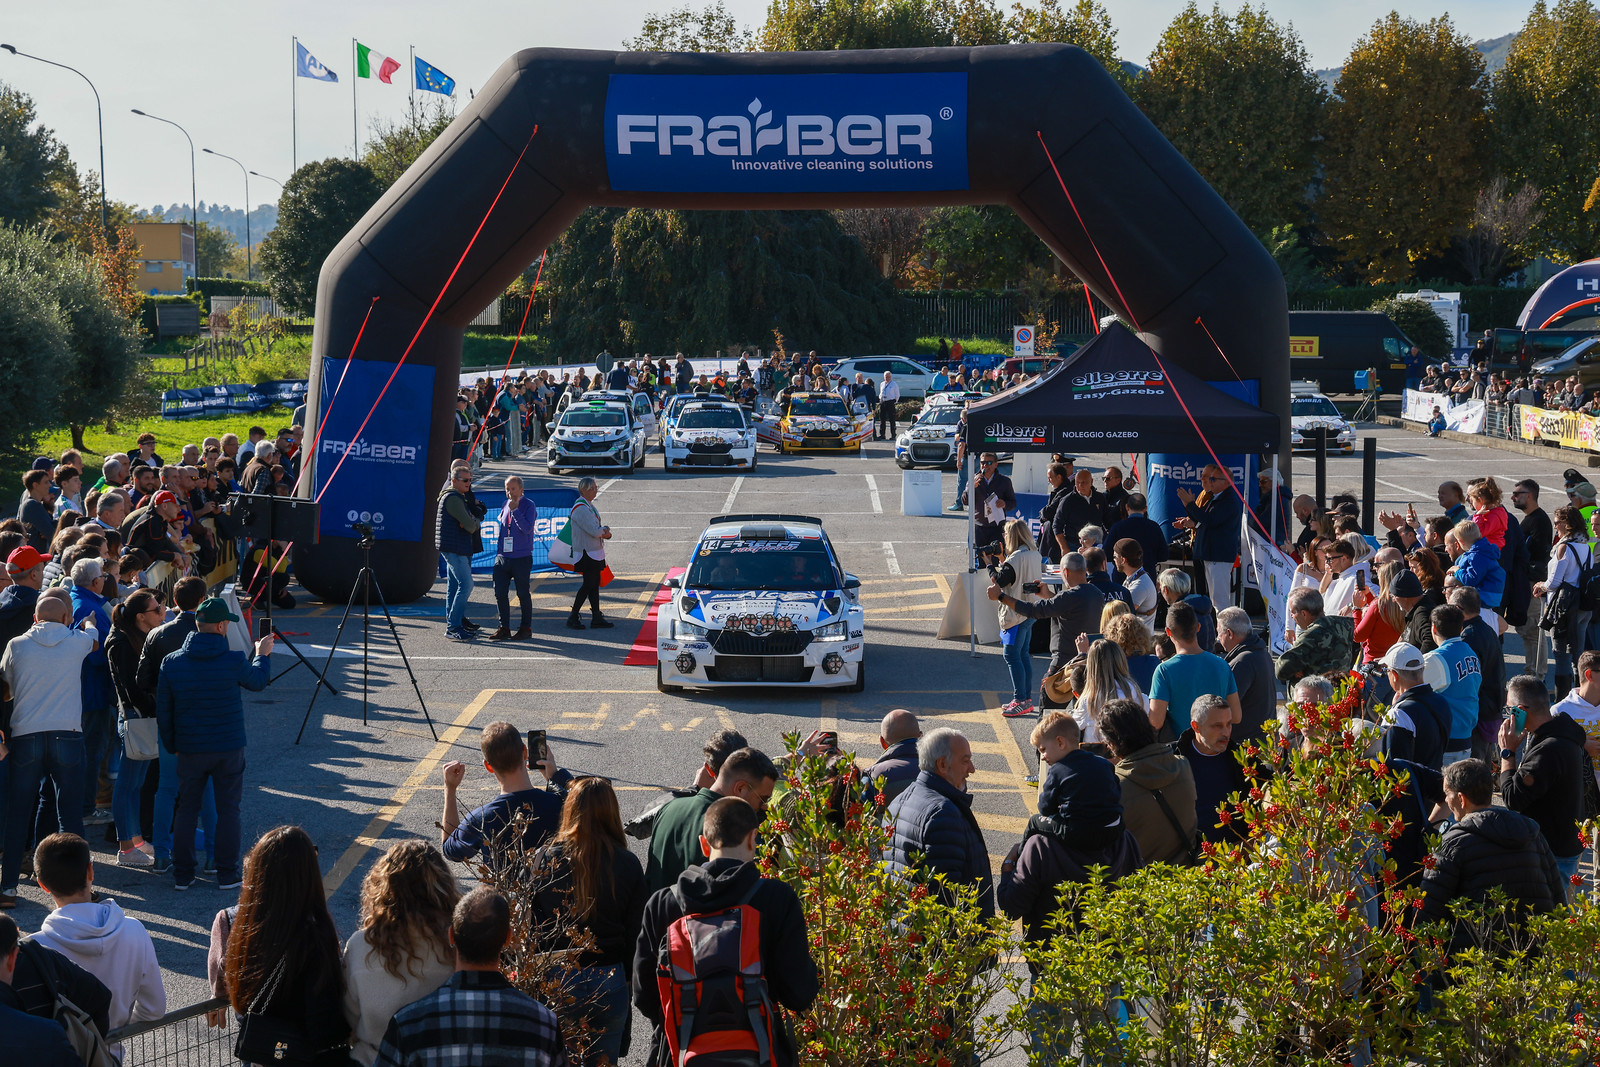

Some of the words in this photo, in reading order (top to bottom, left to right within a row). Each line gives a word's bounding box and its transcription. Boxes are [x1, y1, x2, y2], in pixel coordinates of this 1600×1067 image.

[732, 158, 803, 171] Innovative
[806, 158, 865, 173] cleaning
[869, 158, 933, 171] solutions
[1072, 370, 1164, 387] elleerre
[1073, 388, 1165, 400] Easy-Gazebo
[984, 422, 1046, 438] elleerre
[1062, 431, 1104, 439] NOLEGGIO
[1105, 431, 1139, 439] GAZEBO
[352, 455, 376, 463] Innovative
[703, 540, 719, 550] 14
